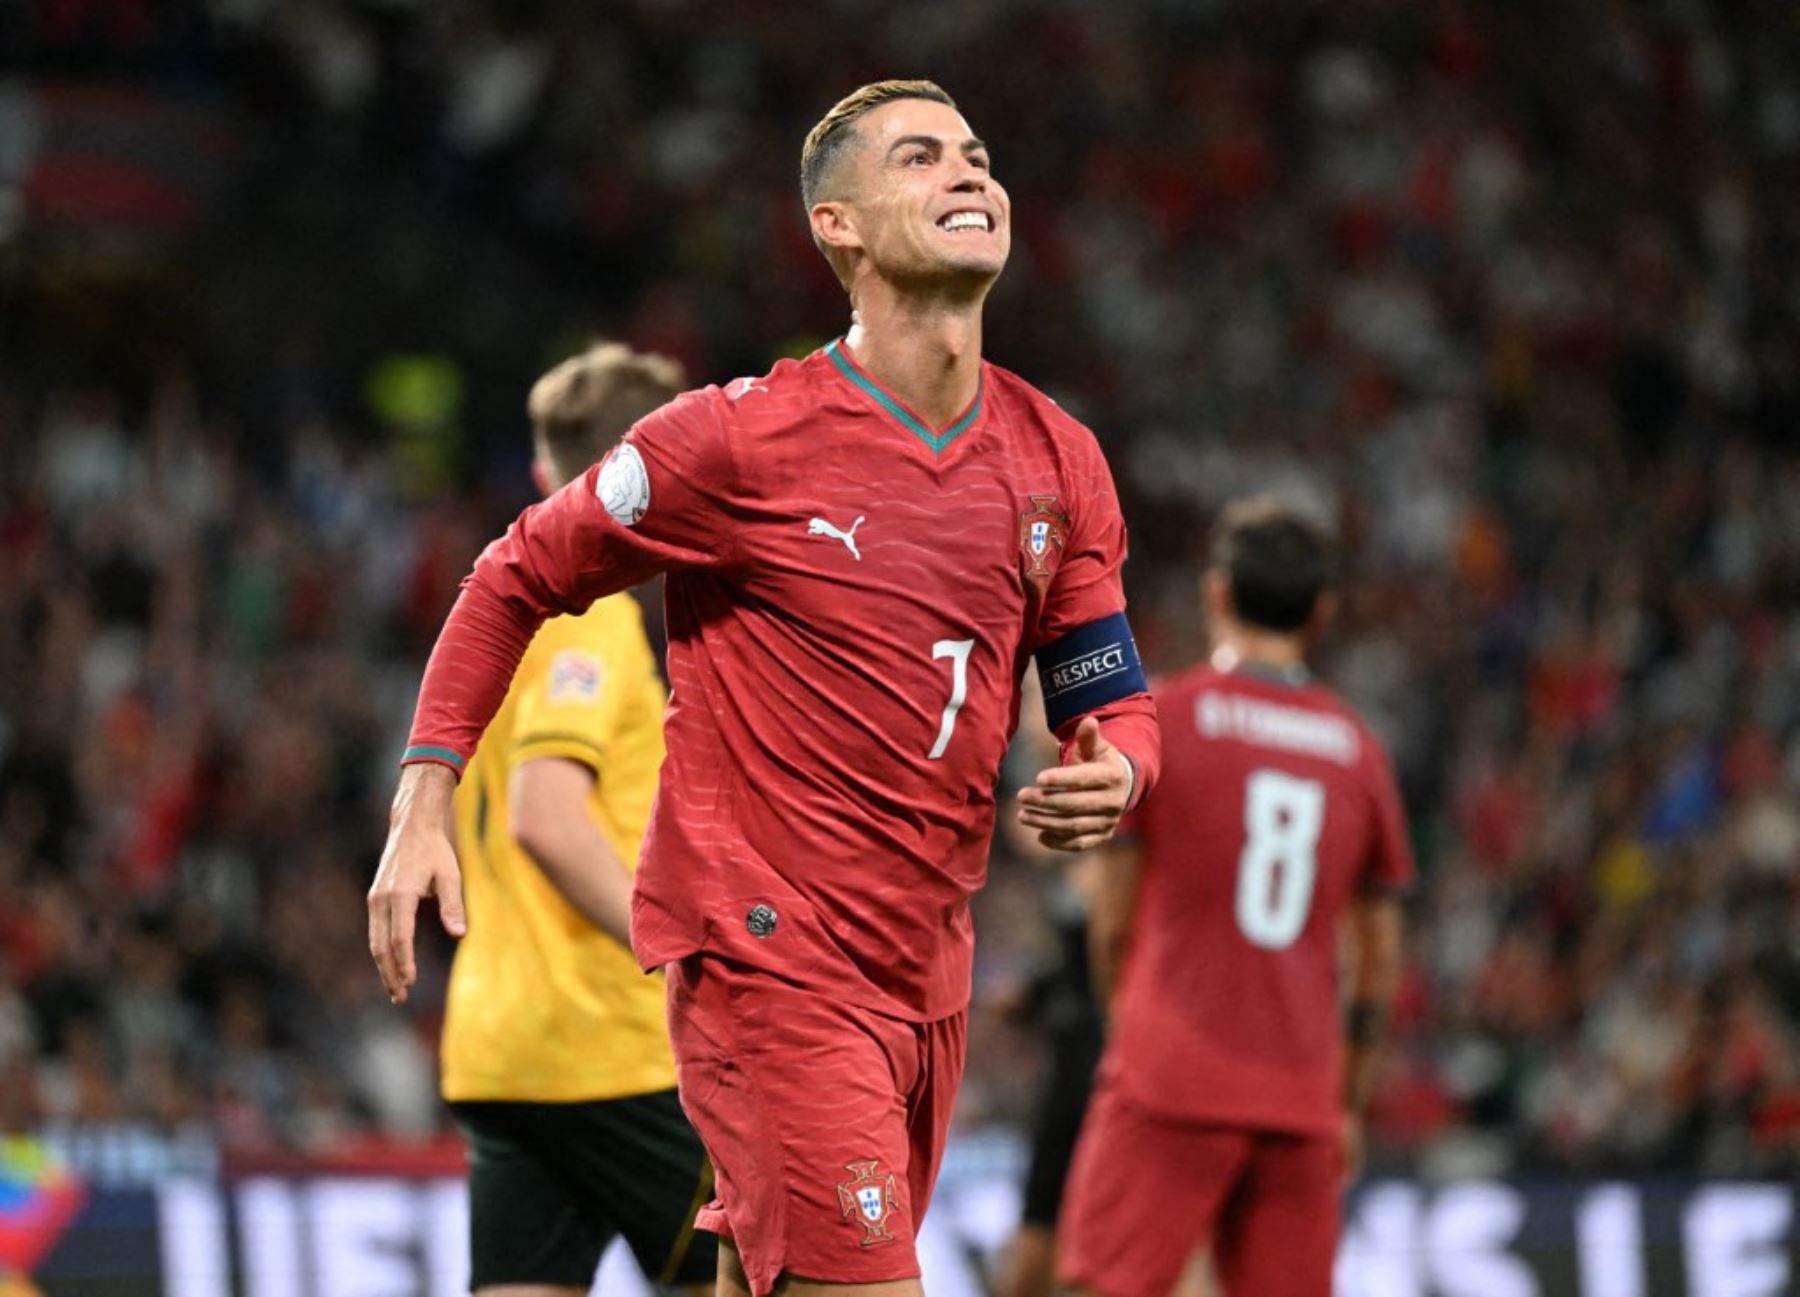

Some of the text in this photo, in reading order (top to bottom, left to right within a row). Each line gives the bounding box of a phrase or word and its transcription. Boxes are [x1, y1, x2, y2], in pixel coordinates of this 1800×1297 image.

[928, 638, 975, 760] 7
[1053, 649, 1123, 688] RESPECT
[1236, 769, 1325, 949] 8
